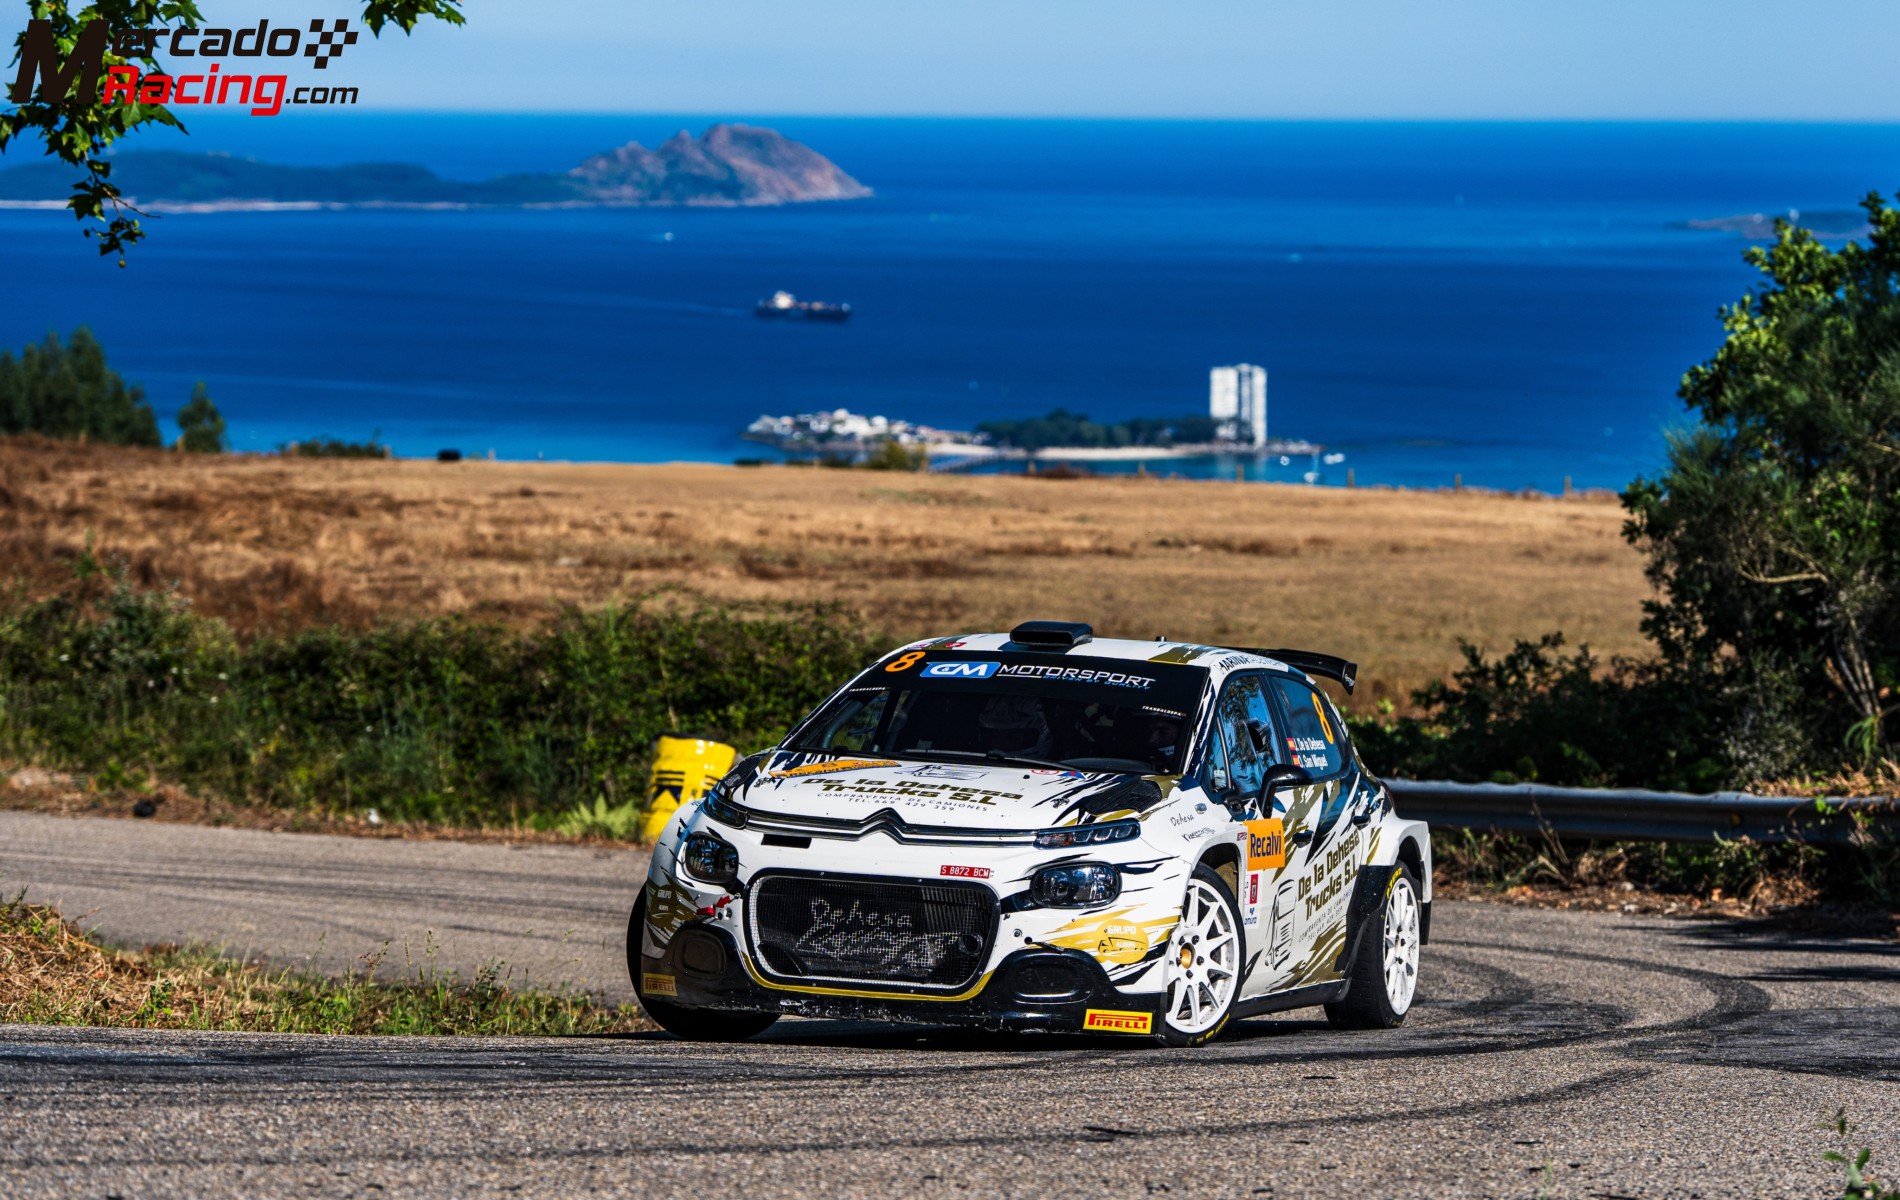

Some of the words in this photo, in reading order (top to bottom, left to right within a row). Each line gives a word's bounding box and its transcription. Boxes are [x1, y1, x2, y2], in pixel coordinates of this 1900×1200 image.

[885, 651, 926, 672] 8
[999, 664, 1156, 687] MOTORSPORT
[1312, 692, 1334, 744] 8
[1307, 737, 1326, 750] Dehesa
[1311, 753, 1328, 770] Miguel
[822, 784, 940, 798] Trucks
[949, 792, 997, 806] S.L
[895, 780, 1023, 800] Dehesa
[817, 793, 901, 801] COMPRAVENTA
[929, 800, 987, 811] CAMIONES
[1170, 813, 1194, 826] Dehesa
[1250, 830, 1282, 858] Recalvi
[942, 865, 947, 874] S
[950, 866, 970, 875] 8872
[974, 868, 989, 877] BCM
[1298, 876, 1311, 901] De
[1314, 864, 1324, 886] la
[1327, 828, 1360, 875] Dehesa
[1305, 874, 1342, 921] Trucks
[1345, 855, 1358, 886] S.L
[1107, 925, 1136, 935] GRUPO
[645, 977, 675, 992] PIRELLI
[1088, 1013, 1148, 1029] PIRELLI
